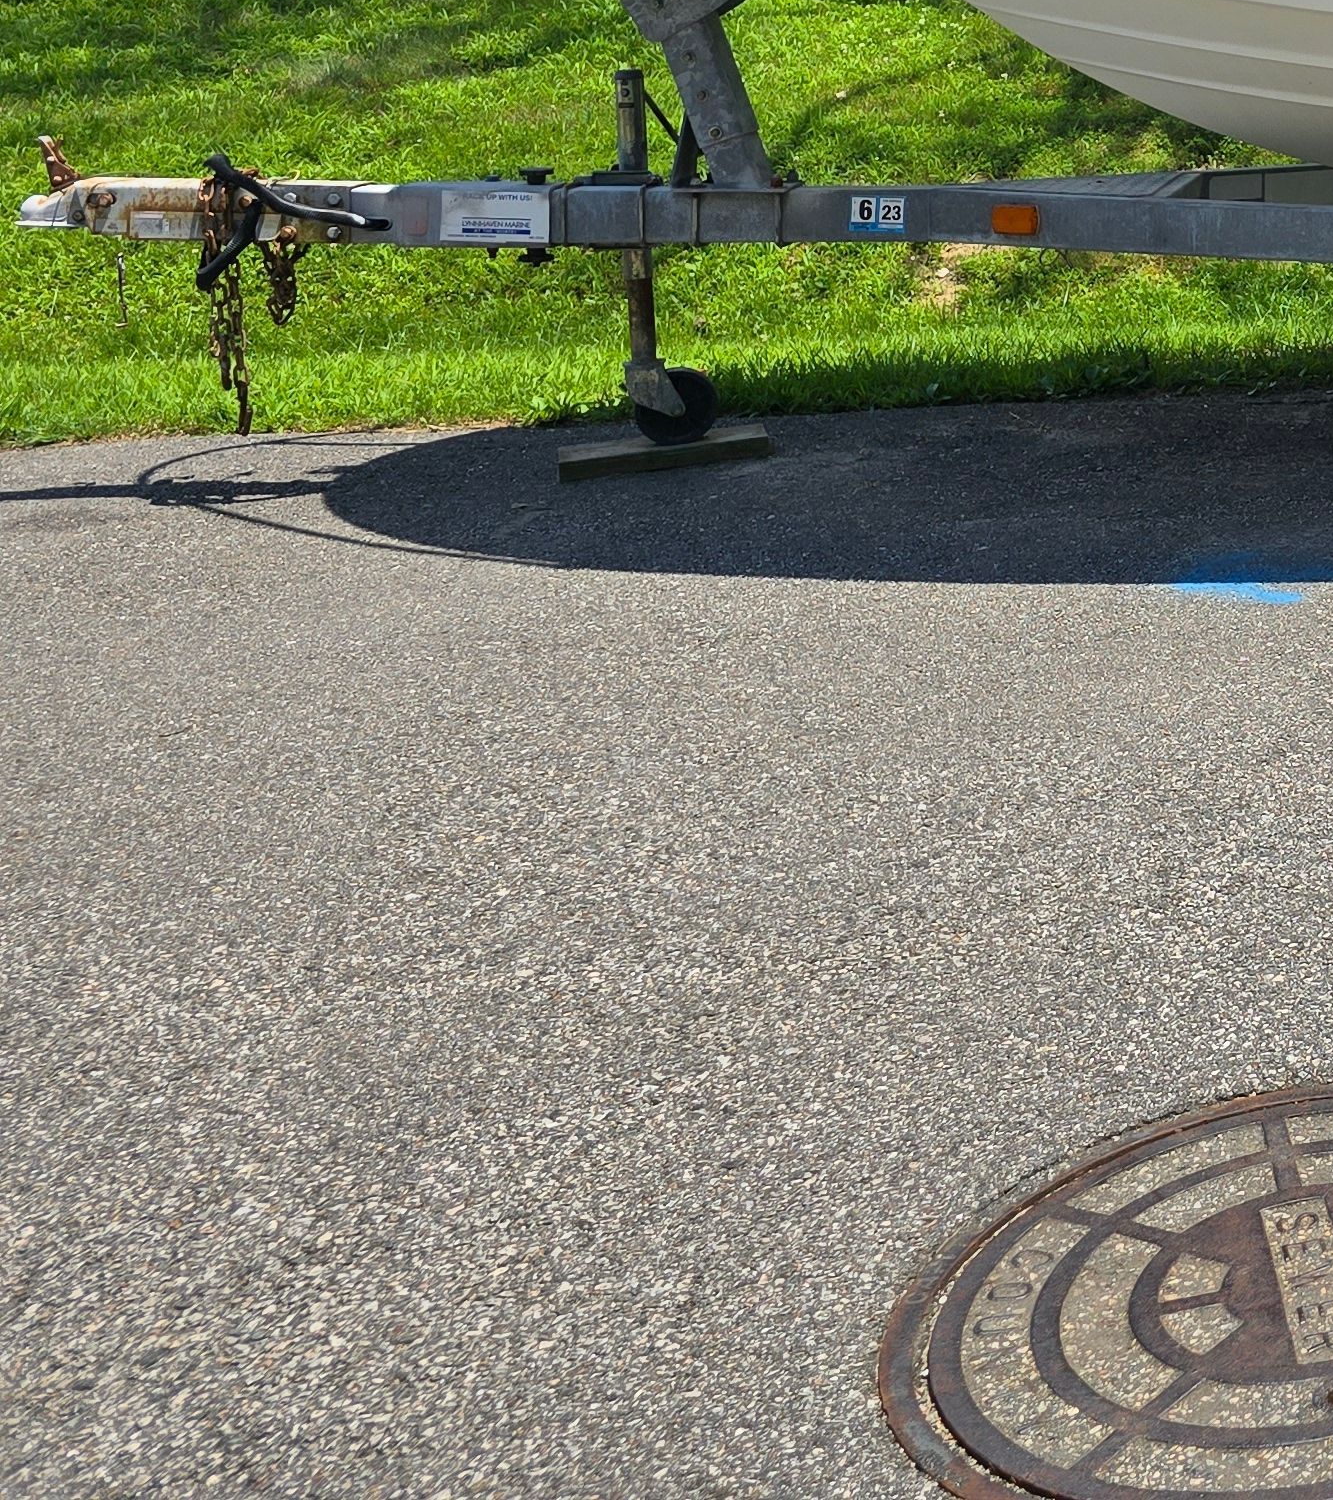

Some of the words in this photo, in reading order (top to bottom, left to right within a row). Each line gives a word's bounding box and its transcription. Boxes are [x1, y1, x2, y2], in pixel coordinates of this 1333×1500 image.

[859, 199, 873, 221] 6
[881, 204, 902, 221] 23
[504, 221, 531, 229] MARINE
